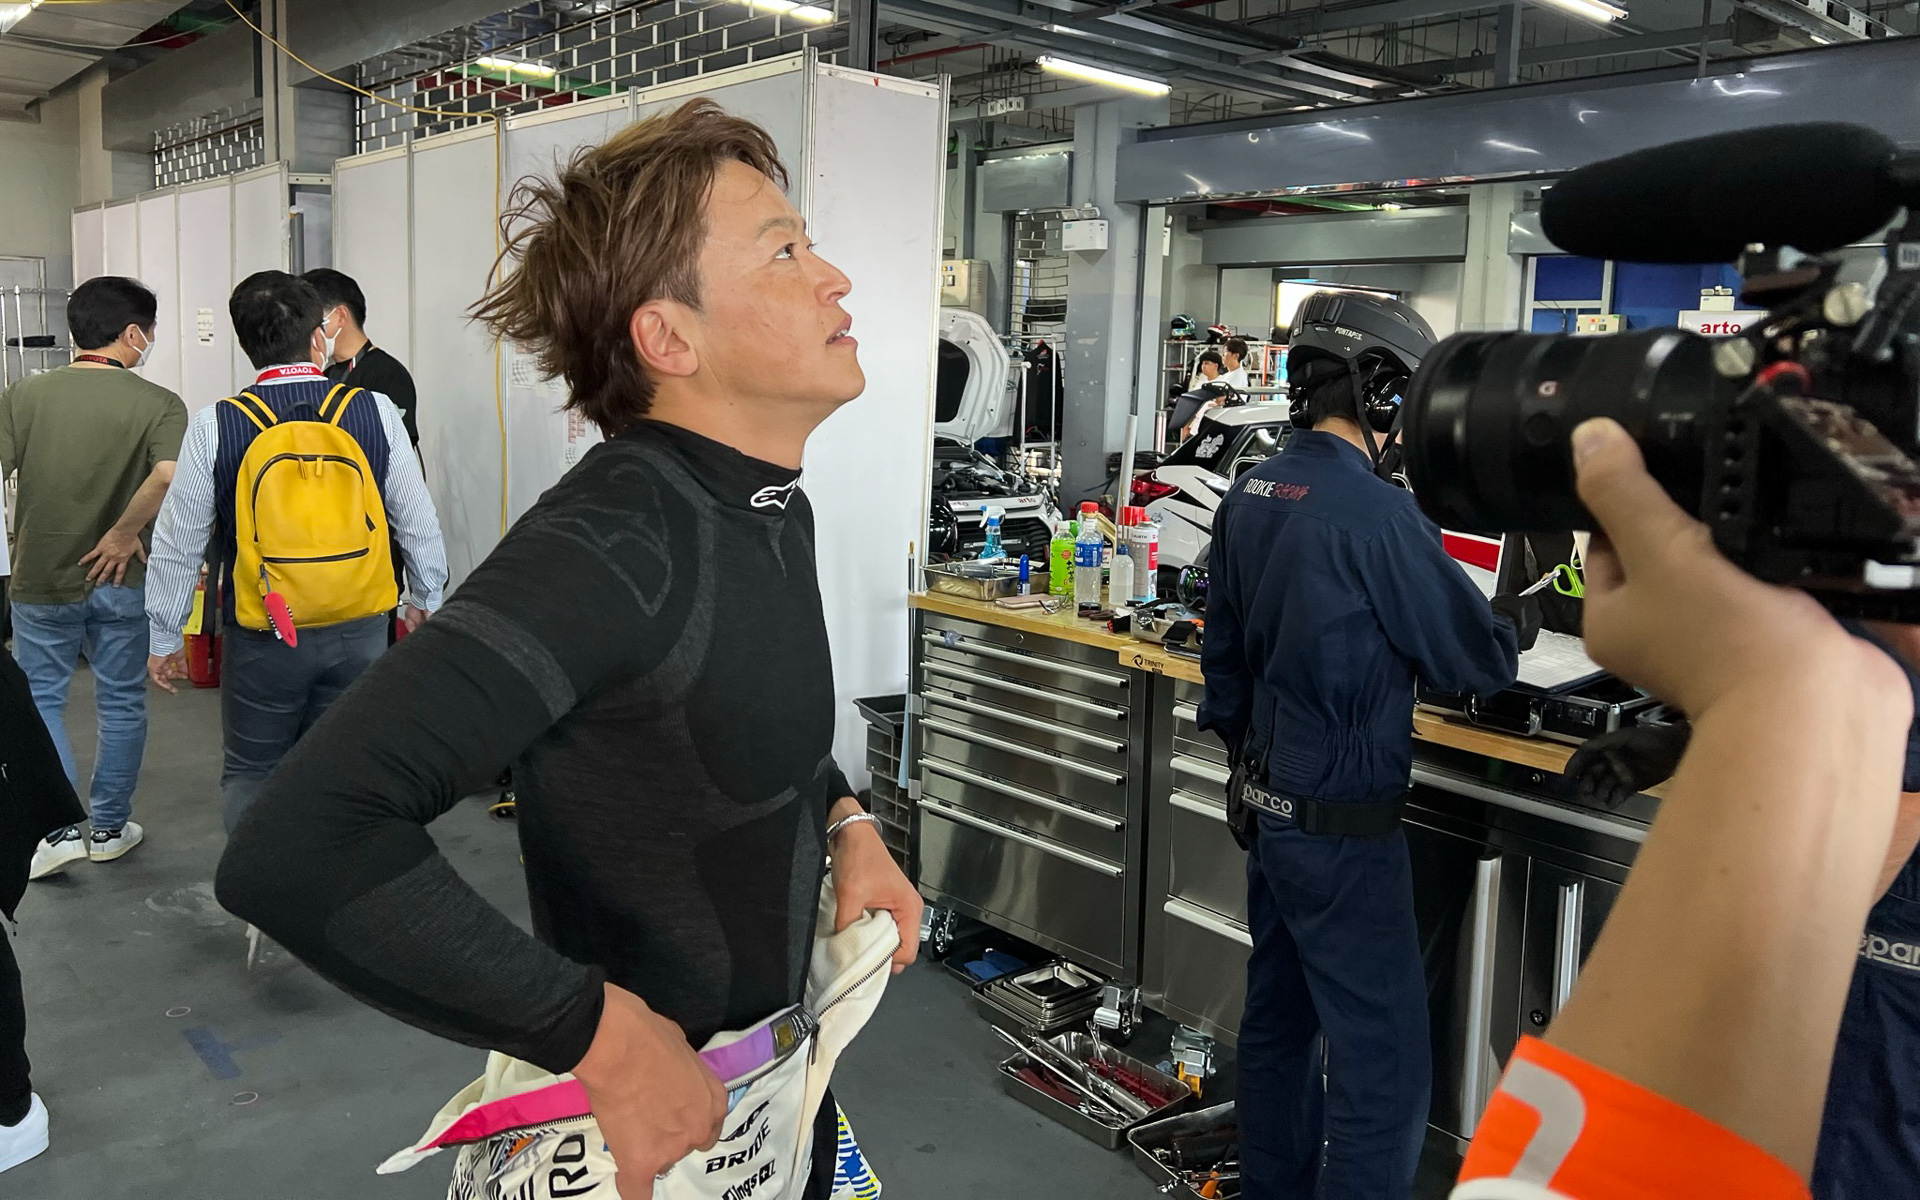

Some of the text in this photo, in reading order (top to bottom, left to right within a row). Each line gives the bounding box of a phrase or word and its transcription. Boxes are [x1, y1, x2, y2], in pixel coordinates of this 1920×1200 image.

[1700, 321, 1741, 334] arto
[81, 355, 110, 364] TOYOTA
[279, 366, 314, 375] TOYOTA
[1243, 478, 1276, 498] ROOKIE
[1144, 658, 1164, 669] TRINITY
[1241, 783, 1293, 814] parco
[705, 1116, 771, 1175] BRIDE
